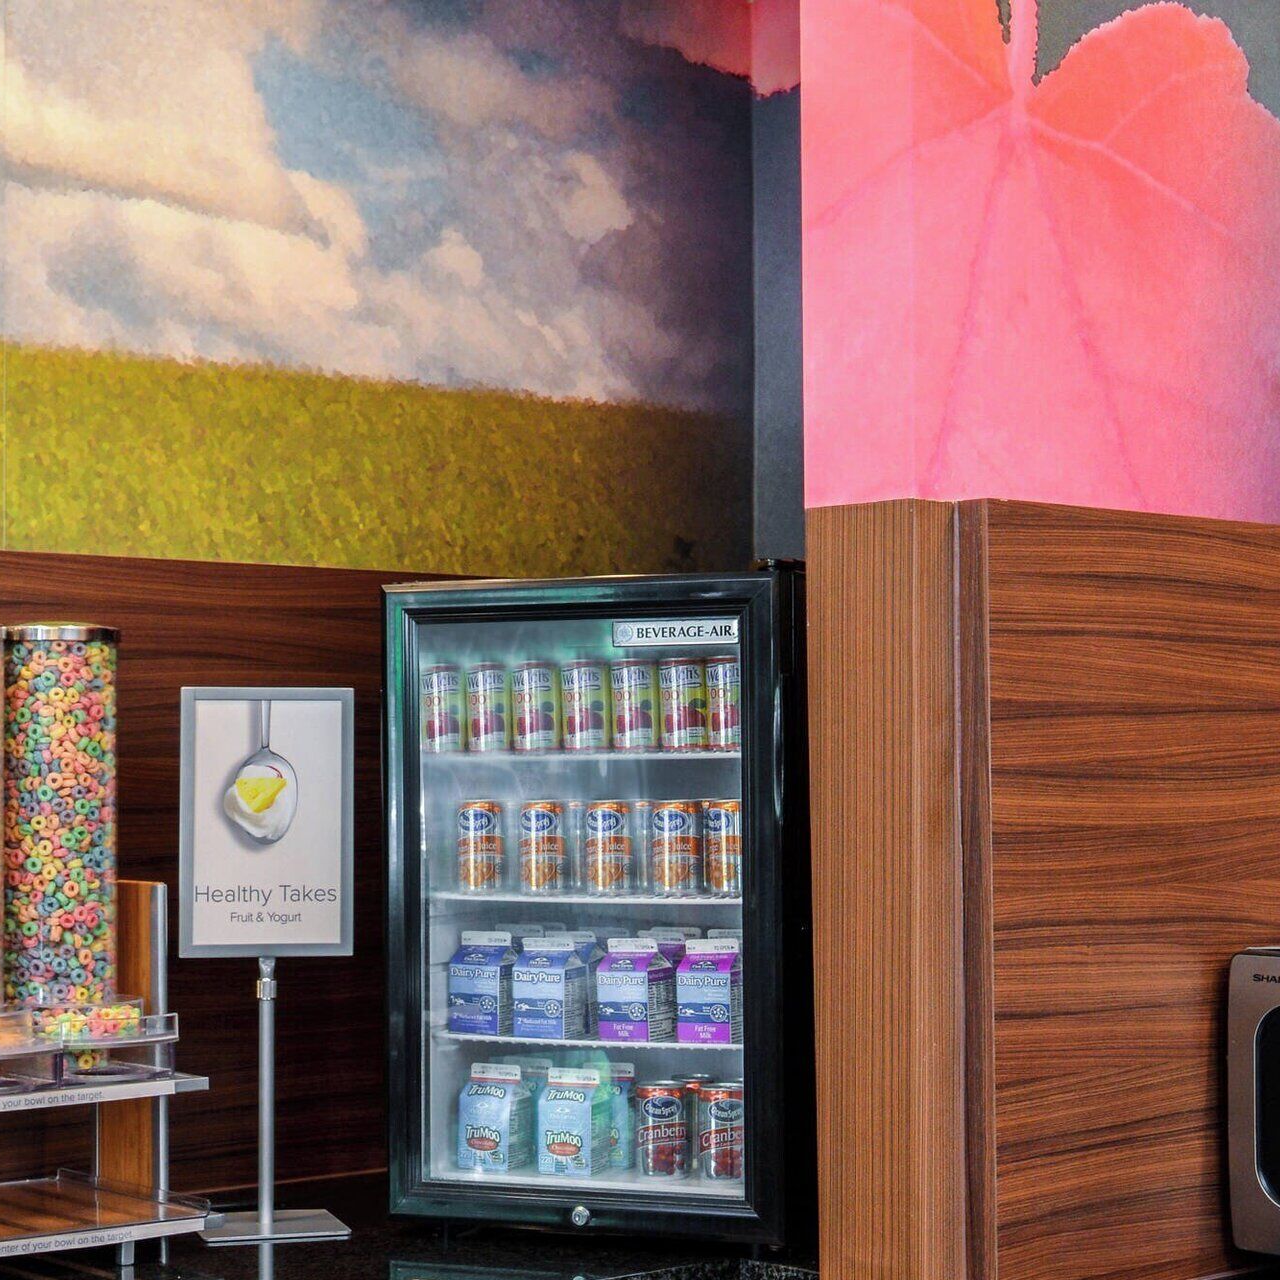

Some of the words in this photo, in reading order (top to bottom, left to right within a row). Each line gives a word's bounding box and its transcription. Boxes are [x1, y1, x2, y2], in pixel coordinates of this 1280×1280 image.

[195, 885, 273, 907] Healthy
[279, 884, 338, 902] Takes
[230, 912, 253, 922] Fruit
[255, 912, 264, 922] &
[267, 912, 302, 924] Yogurt
[451, 967, 496, 979] DairyPure
[514, 971, 560, 984] DairyPure
[598, 976, 644, 987] DairyPure
[678, 977, 726, 988] DairyPure
[469, 1084, 506, 1098] TruMoo
[547, 1089, 586, 1102] TruMoo
[2, 1099, 22, 1110] your
[25, 1096, 47, 1107] bowl
[47, 1096, 59, 1104] on
[61, 1094, 75, 1102] the
[465, 1125, 500, 1142] TruMoo
[545, 1131, 583, 1147] TruMoo
[21, 1241, 31, 1251] of
[32, 1241, 52, 1251] your
[54, 1238, 76, 1248] bowl
[77, 1237, 89, 1245] on
[91, 1234, 105, 1243] the
